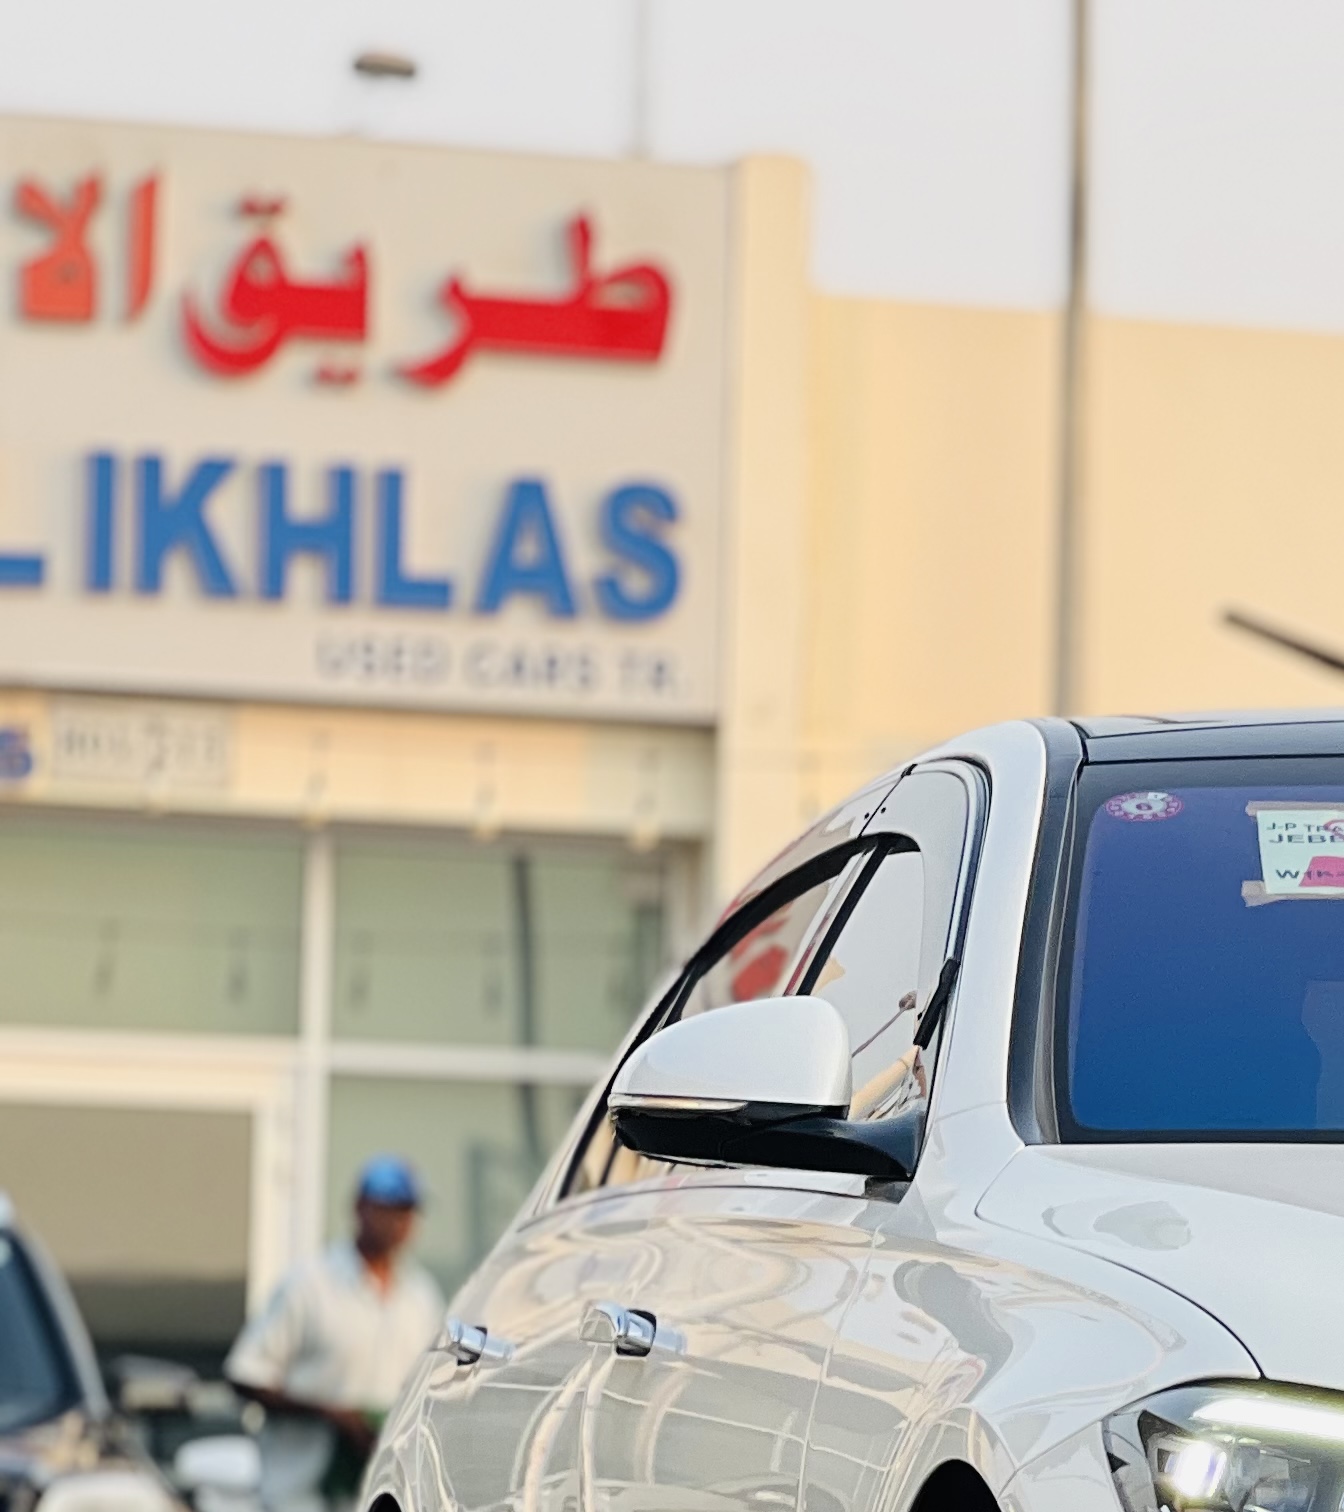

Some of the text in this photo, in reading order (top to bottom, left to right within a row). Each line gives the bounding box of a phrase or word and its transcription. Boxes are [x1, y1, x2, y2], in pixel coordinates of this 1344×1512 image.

[182, 194, 677, 390] طريق
[84, 448, 684, 624] IKHLAS
[316, 636, 450, 684] USED
[464, 642, 596, 692] CARS
